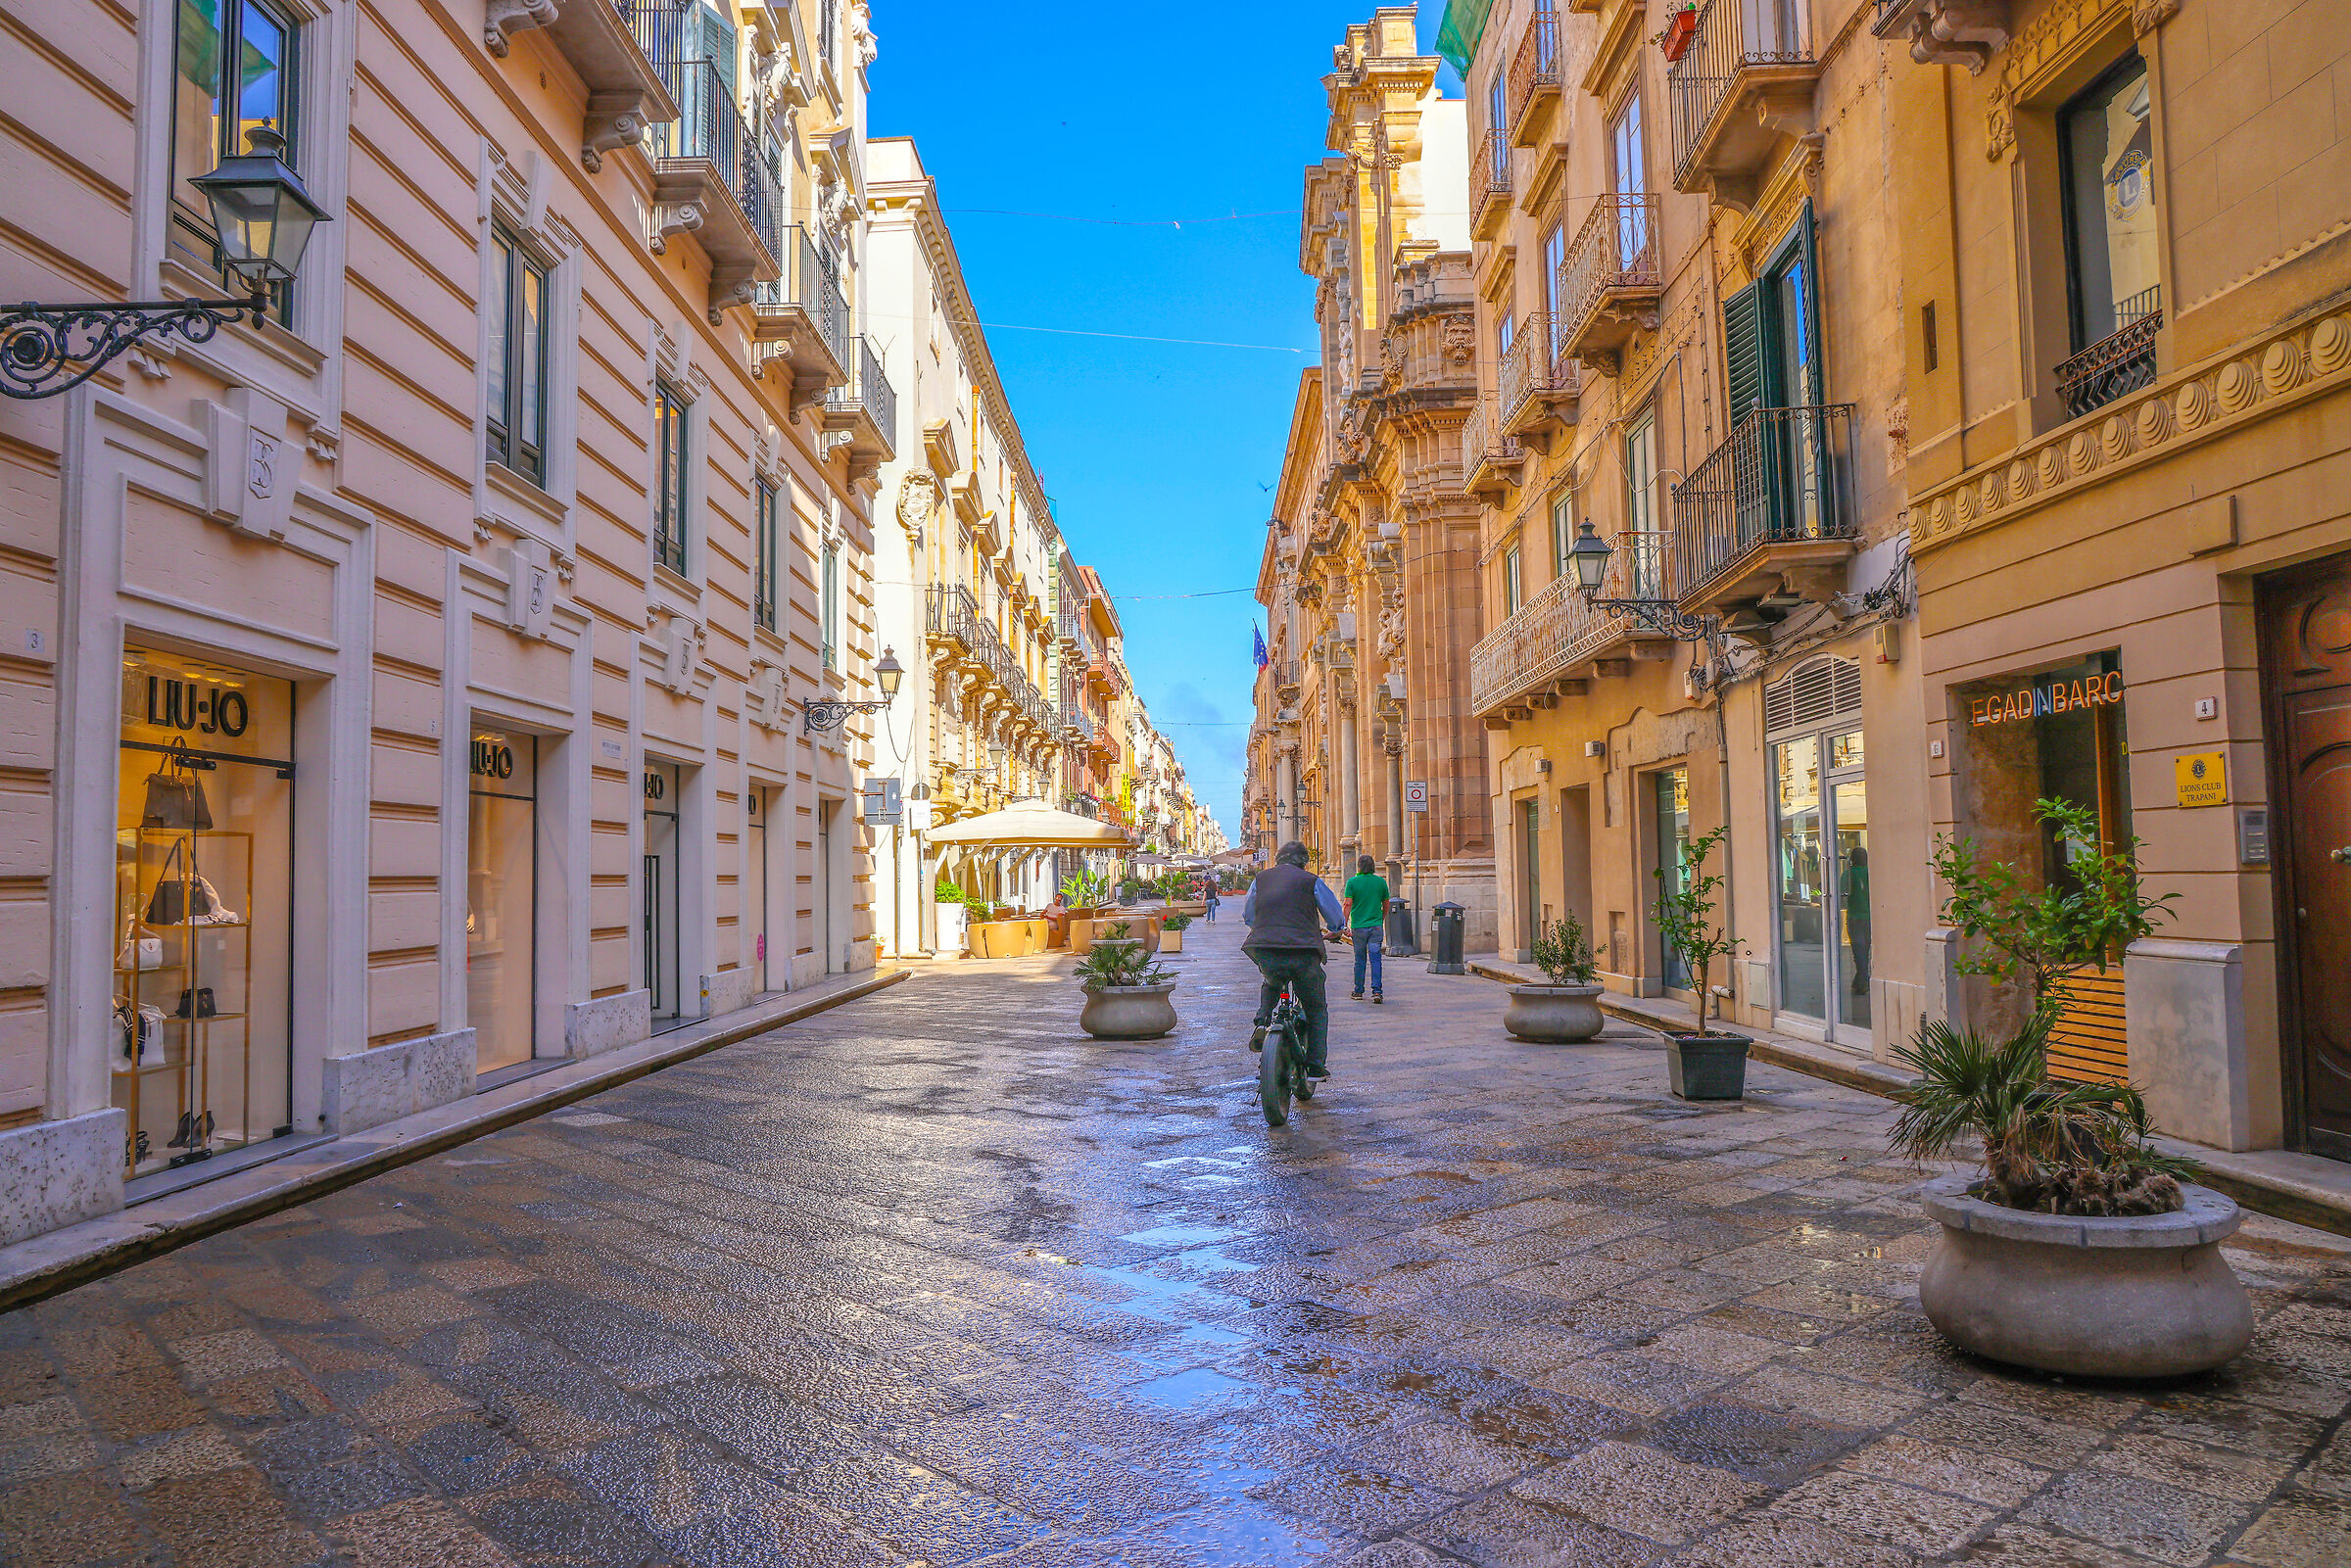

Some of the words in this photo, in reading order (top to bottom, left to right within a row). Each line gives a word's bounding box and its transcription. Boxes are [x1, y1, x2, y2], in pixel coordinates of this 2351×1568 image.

[30, 633, 38, 649] 3
[2201, 702, 2208, 715] 4
[2180, 784, 2201, 794] LIONS
[2201, 781, 2222, 792] CLUB
[2186, 792, 2217, 803] TRAPANI
